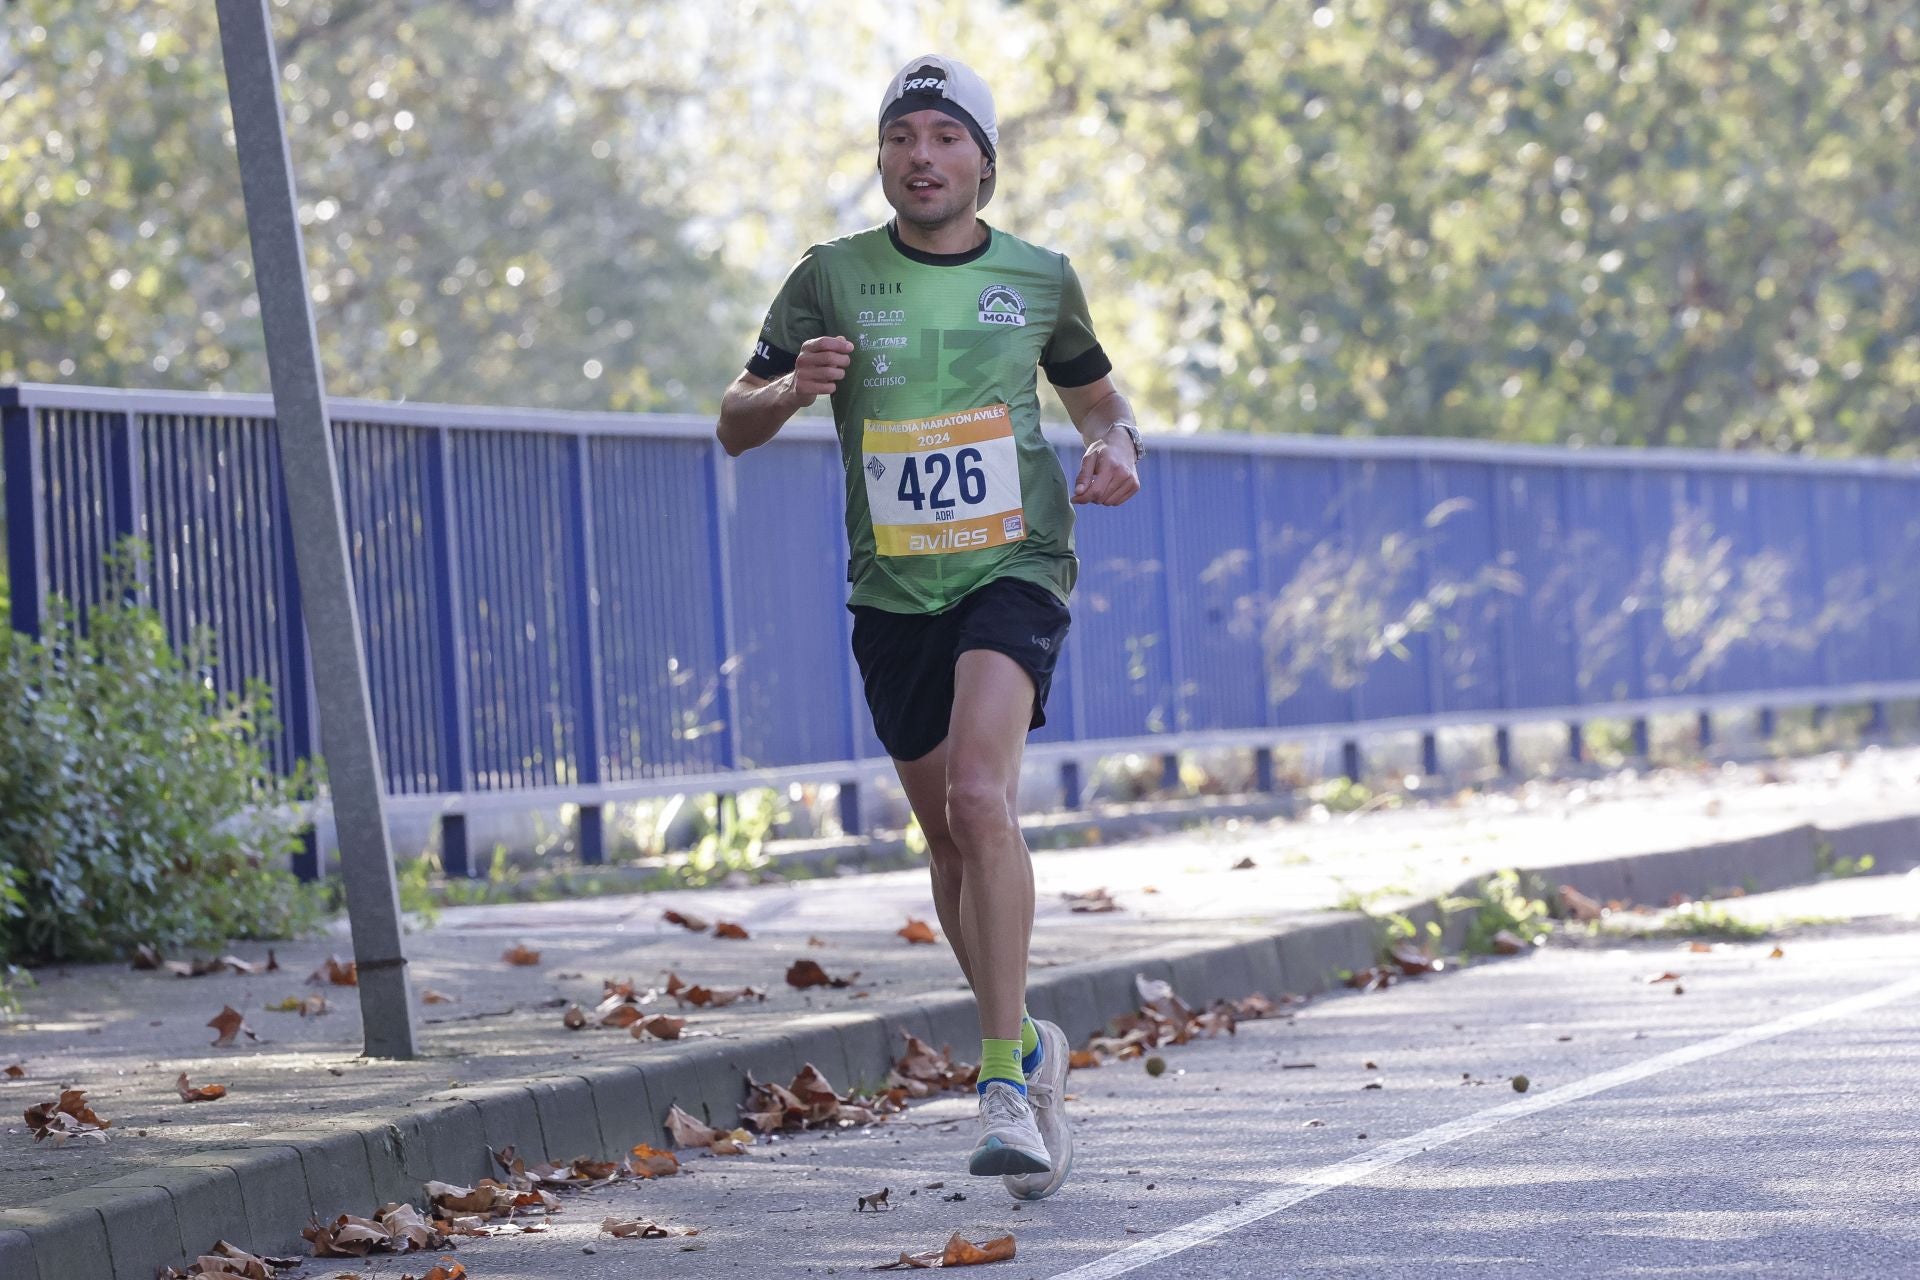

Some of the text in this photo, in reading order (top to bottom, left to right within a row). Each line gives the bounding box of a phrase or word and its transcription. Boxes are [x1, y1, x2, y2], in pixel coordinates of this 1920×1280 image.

[860, 282, 902, 295] GOBIK
[859, 310, 905, 323] mpm
[983, 313, 1021, 324] MOAL
[888, 423, 920, 433] MEDIA
[920, 413, 972, 430] MARATÓN
[973, 407, 1006, 422] AVILÉS
[917, 432, 950, 447] 2024
[897, 447, 987, 511] 426
[935, 509, 955, 522] ADRI
[909, 527, 988, 551] avilés
